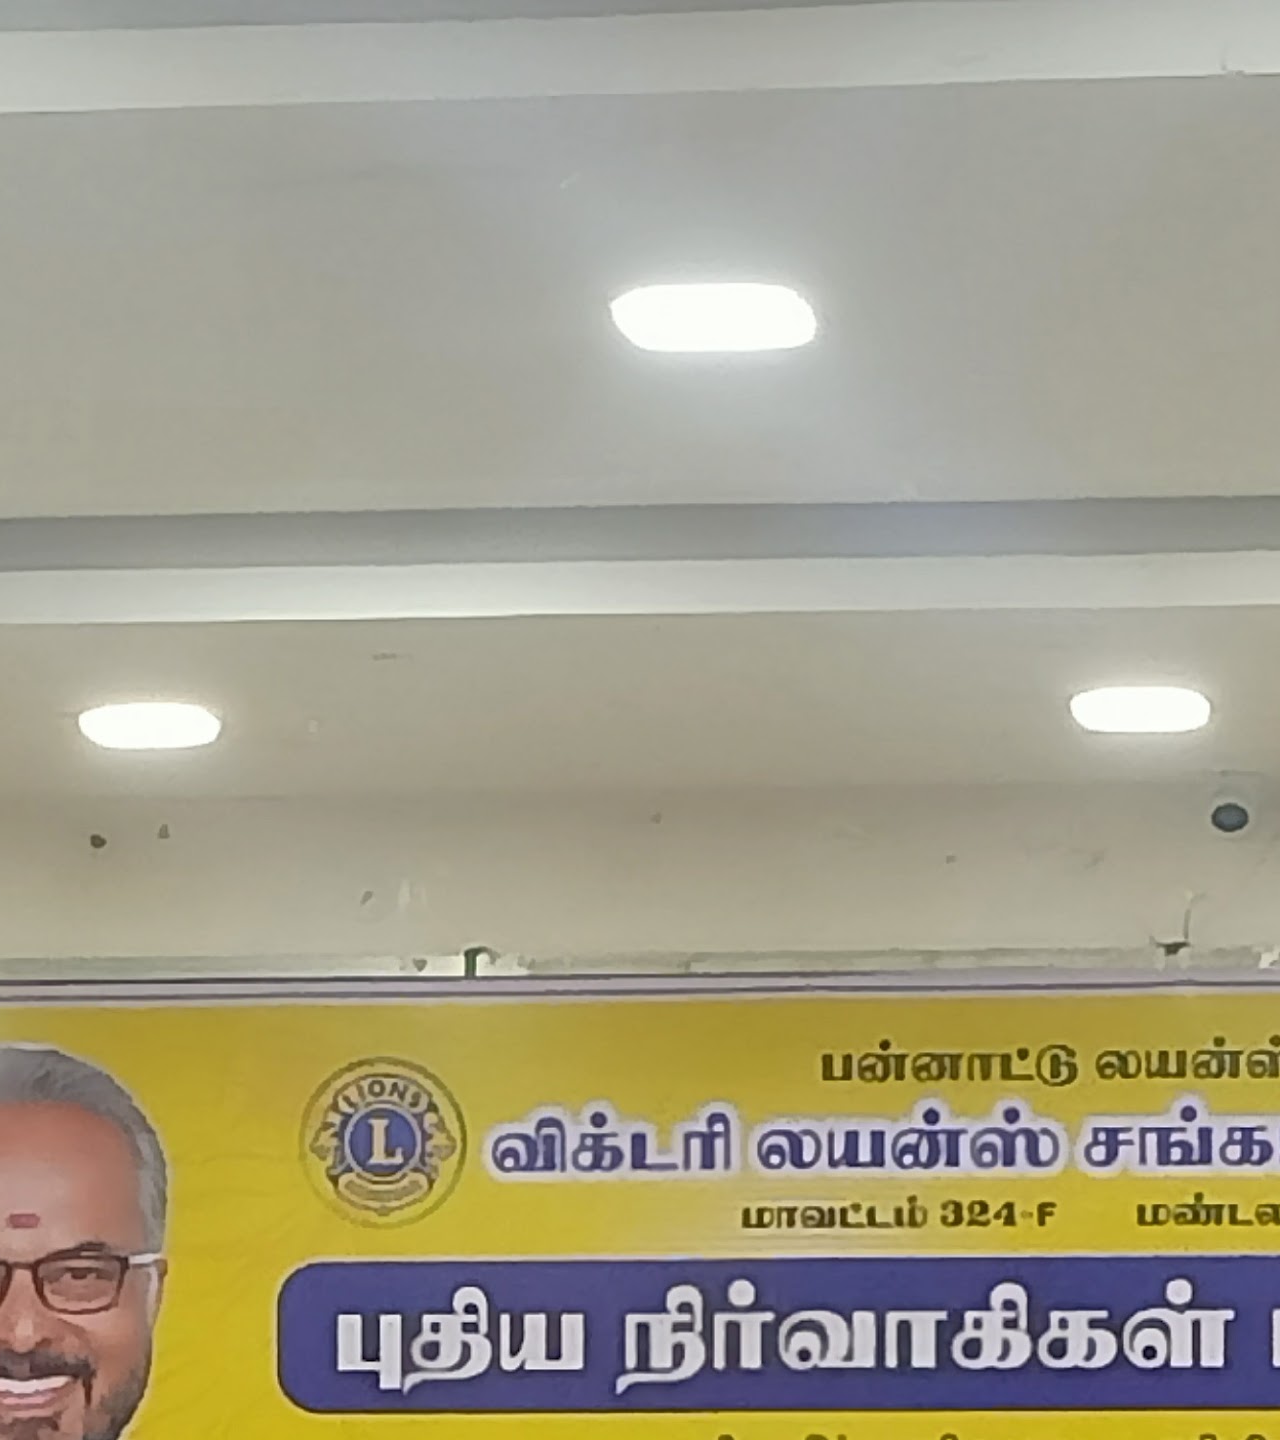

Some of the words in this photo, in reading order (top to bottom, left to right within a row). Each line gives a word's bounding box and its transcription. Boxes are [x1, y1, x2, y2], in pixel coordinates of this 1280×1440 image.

[338, 1078, 424, 1112] LIONS
[366, 1117, 405, 1165] L
[490, 1111, 731, 1174] விக்டரி
[756, 1106, 1061, 1171] லயன்ஸ்
[740, 1195, 926, 1230] மாவட்டம்
[335, 1287, 585, 1393] புதிய
[616, 1278, 1235, 1394] நிர்வாகிகள்
